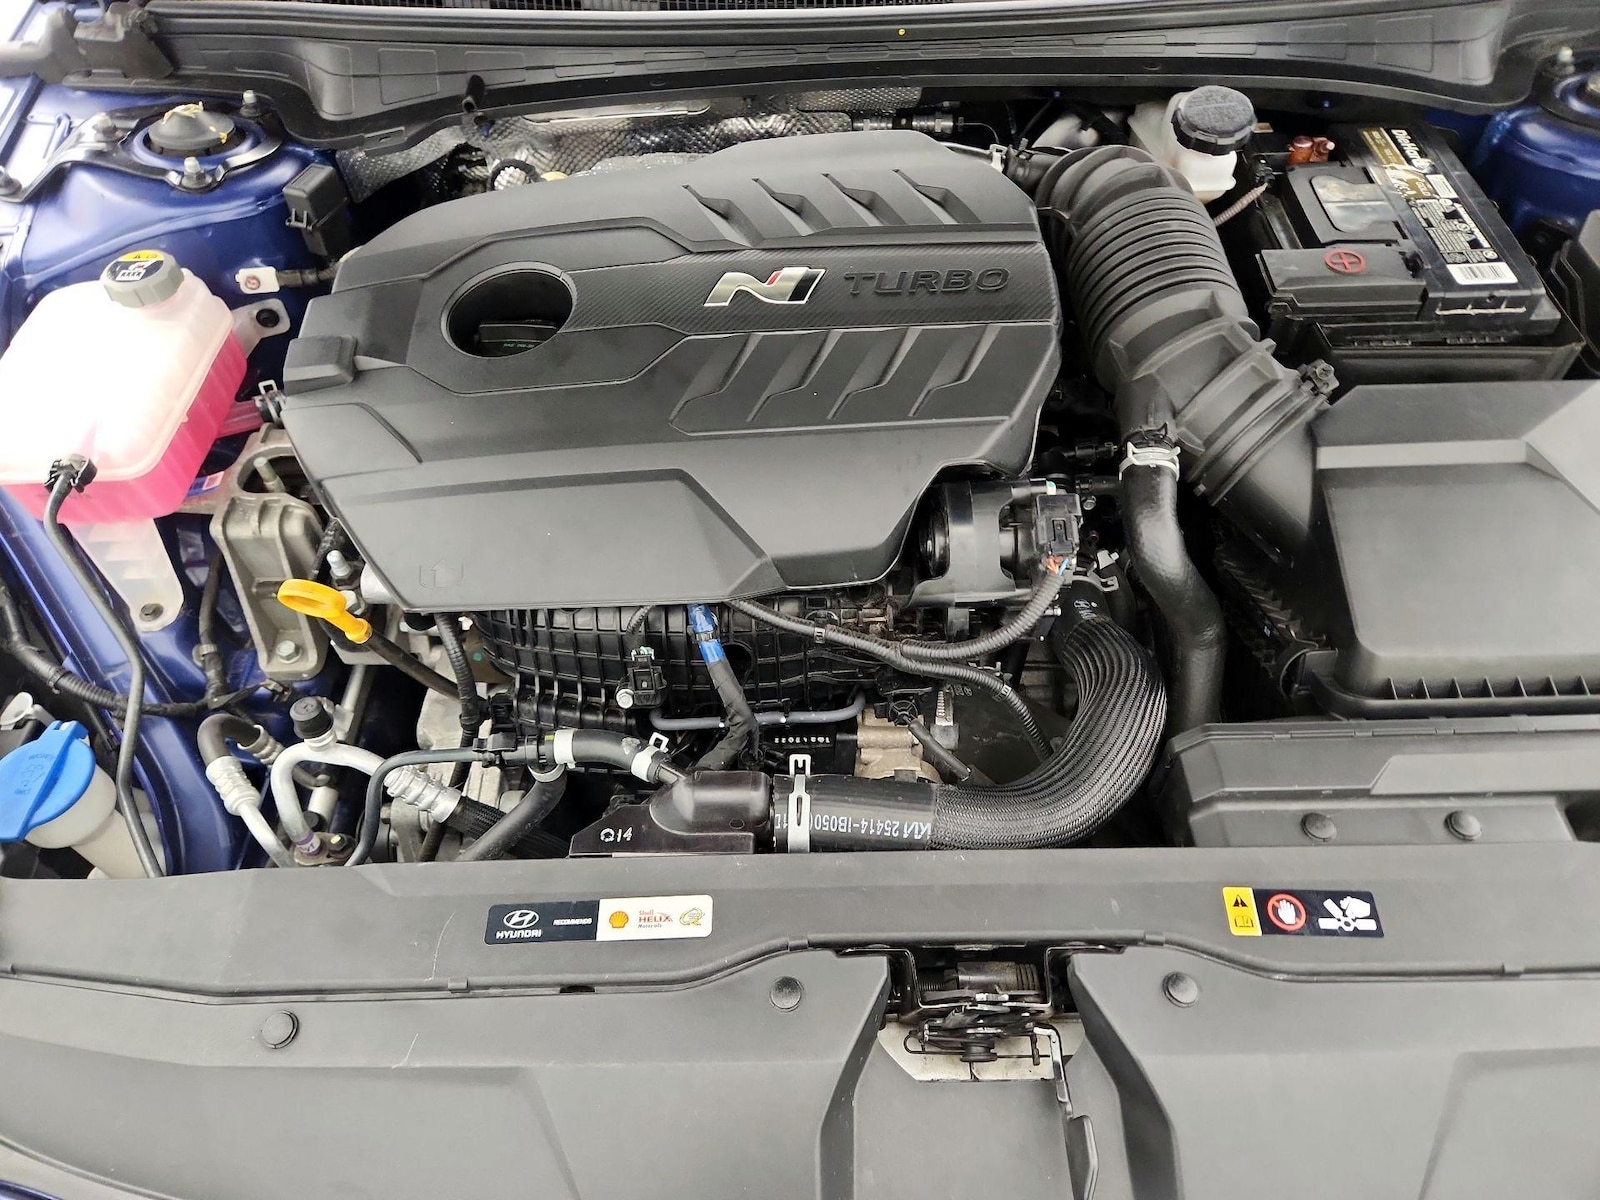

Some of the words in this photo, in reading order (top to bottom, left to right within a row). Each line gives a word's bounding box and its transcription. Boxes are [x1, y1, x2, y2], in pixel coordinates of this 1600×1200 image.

[844, 268, 1011, 295] TURBO
[496, 929, 542, 939] HYUNDAI
[553, 918, 593, 926] RECOMMENDS
[639, 915, 671, 923] HELIX
